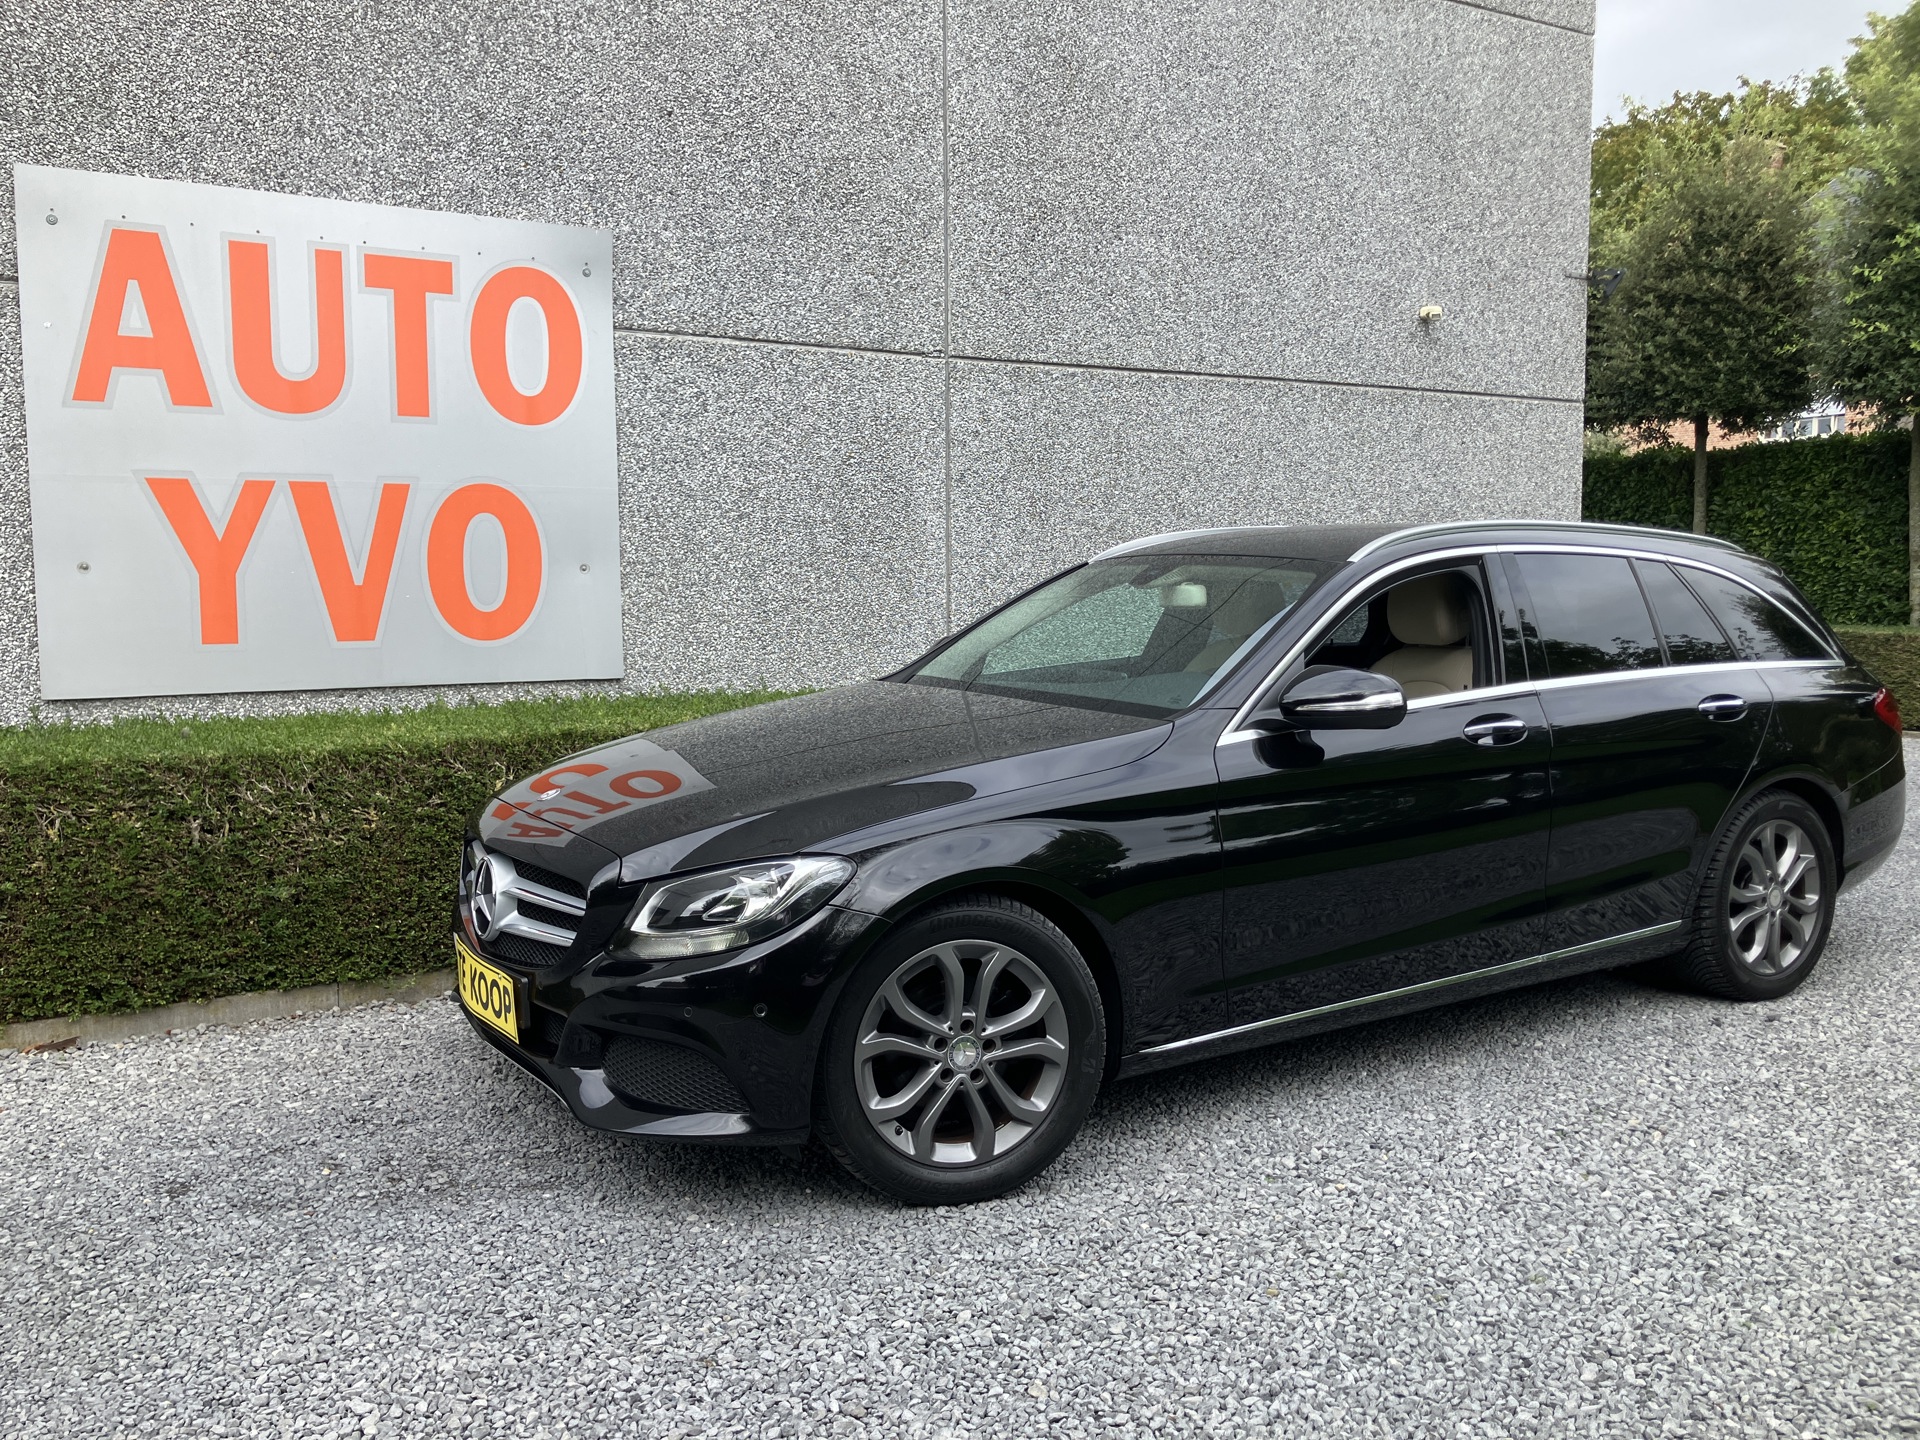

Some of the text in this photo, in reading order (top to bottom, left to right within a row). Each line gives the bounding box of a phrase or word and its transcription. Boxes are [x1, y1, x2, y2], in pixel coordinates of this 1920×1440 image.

[72, 228, 583, 426] AUTO
[144, 477, 542, 645] YVO
[469, 963, 512, 1024] KOOP
